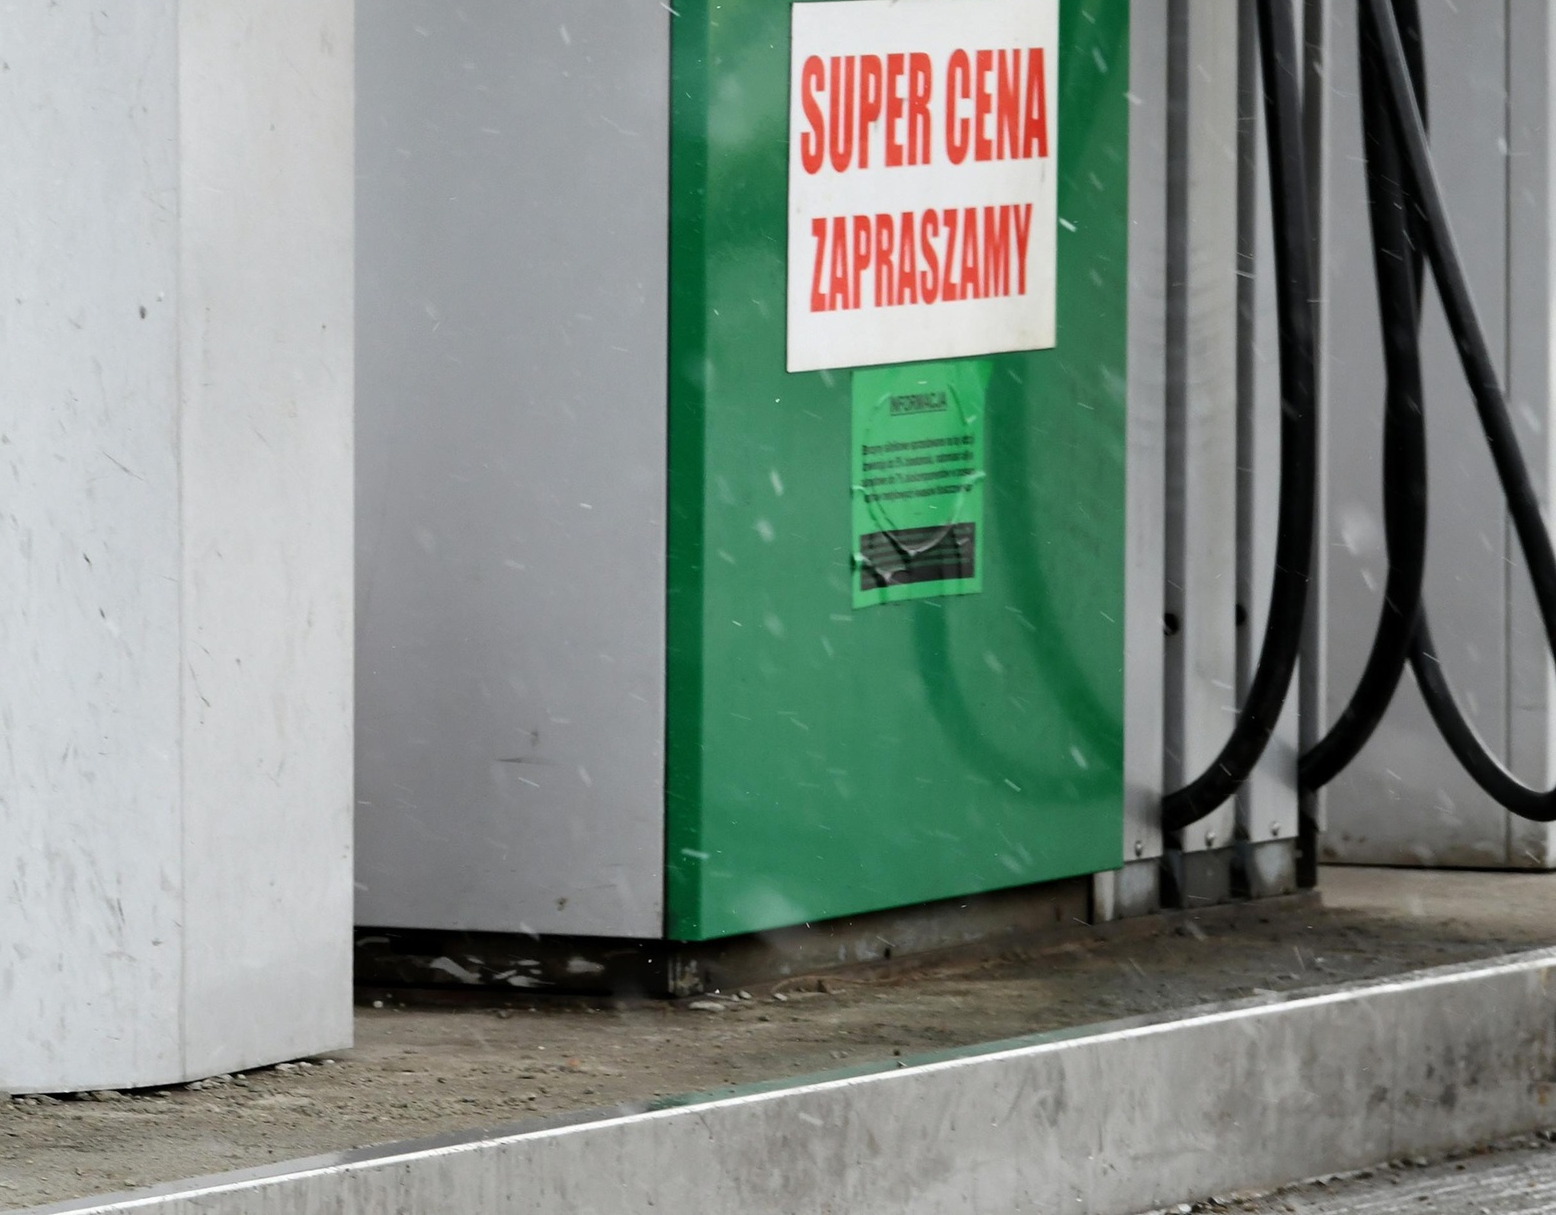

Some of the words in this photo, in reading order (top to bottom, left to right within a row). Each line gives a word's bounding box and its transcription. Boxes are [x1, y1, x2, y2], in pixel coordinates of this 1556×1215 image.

[800, 51, 932, 175] SUPER
[945, 47, 1049, 166] CENA
[809, 203, 1033, 313] ZAPRASZAMY
